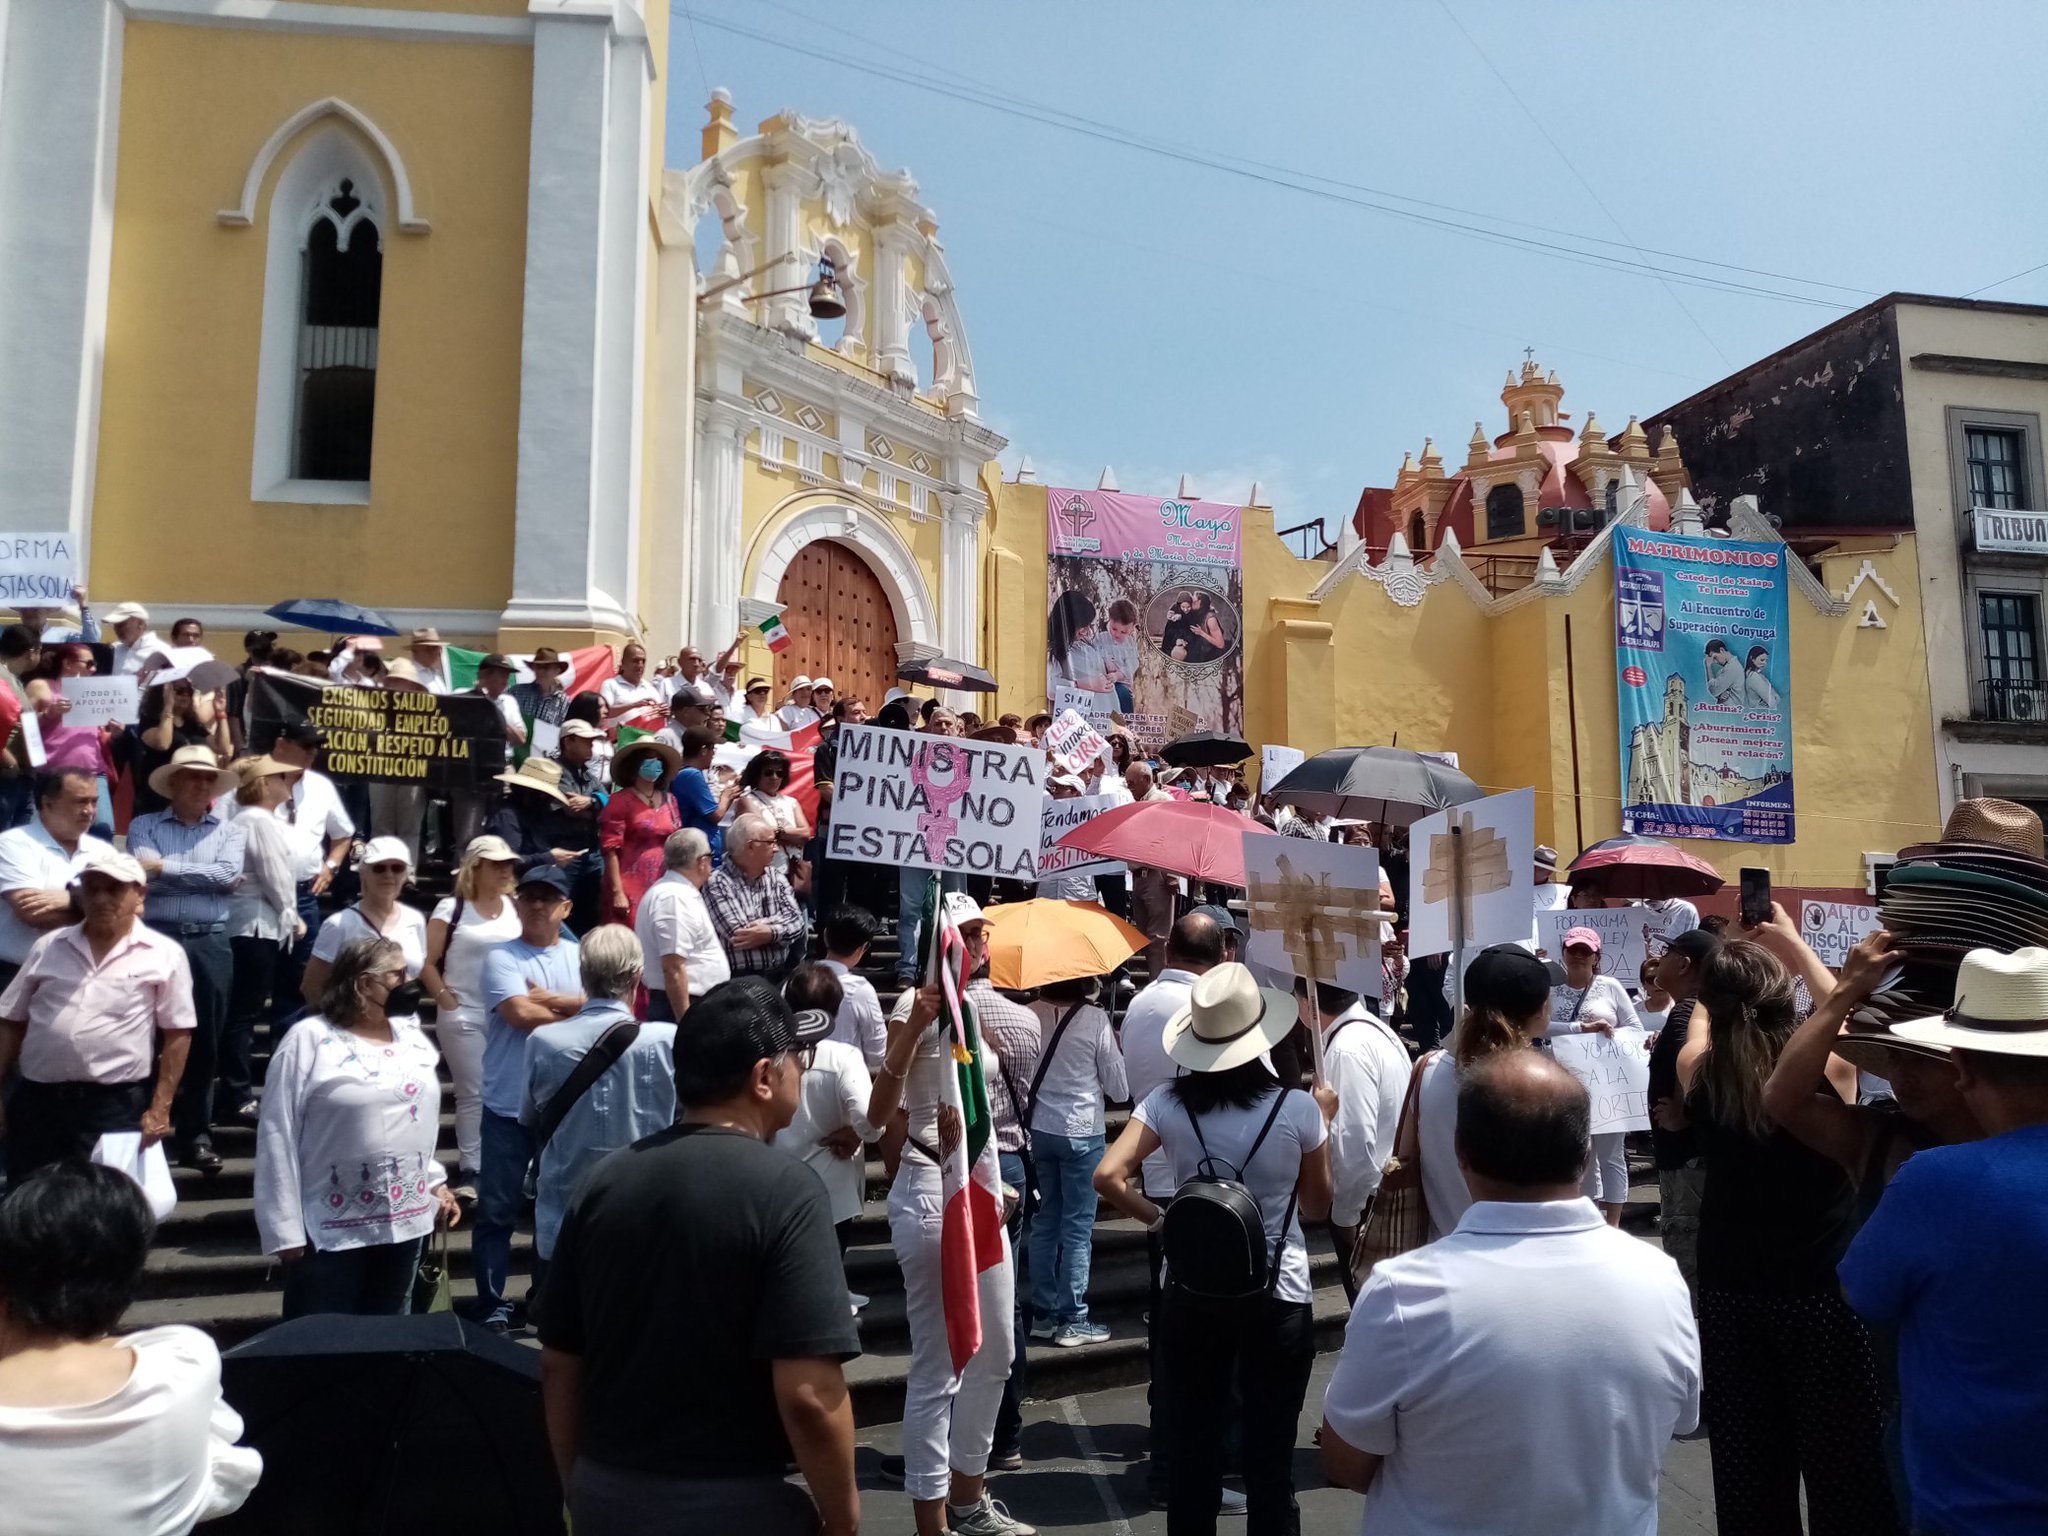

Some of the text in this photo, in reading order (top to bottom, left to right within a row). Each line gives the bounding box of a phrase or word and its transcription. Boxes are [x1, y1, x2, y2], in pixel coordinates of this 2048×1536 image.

[1159, 500, 1232, 540] Mayo
[1978, 510, 2048, 543] TRIBUN
[1628, 539, 1778, 568] MATRIMONIOS
[1676, 573, 1773, 589] Catedral de Xalapa
[1698, 586, 1748, 597] Te Invita:
[1680, 602, 1765, 619] Al Encuentro de
[1669, 619, 1775, 640] Superación Conyuga
[322, 687, 440, 717] EXIGIMOS SALUD,
[1695, 703, 1742, 713] ¿Rutina?
[307, 708, 452, 739] SEGURIDAD, EMPLEO,
[1089, 711, 1111, 719] ADRE
[1129, 725, 1162, 733] PEORES
[377, 734, 436, 756] RESPETO
[439, 739, 448, 757] A
[452, 740, 469, 758] LA
[1697, 735, 1738, 745] ¿Desean
[328, 753, 428, 777] CONSTITUCIÓN
[840, 728, 1035, 786] MINISTRA
[961, 791, 1015, 827] NO
[1625, 810, 1659, 820] FECHA:
[1643, 822, 1655, 832] 27
[1041, 832, 1053, 849] la
[943, 838, 1038, 880] SOLA
[1827, 904, 1870, 922] ALTO
[1554, 916, 1577, 930] POR
[1838, 920, 1858, 935] AL
[1602, 931, 1629, 949] LEY
[1803, 932, 1864, 951] DISCUR
[1580, 1042, 1601, 1059] YO
[1590, 1066, 1629, 1085] A LA
[1591, 1091, 1648, 1123] ORTE
